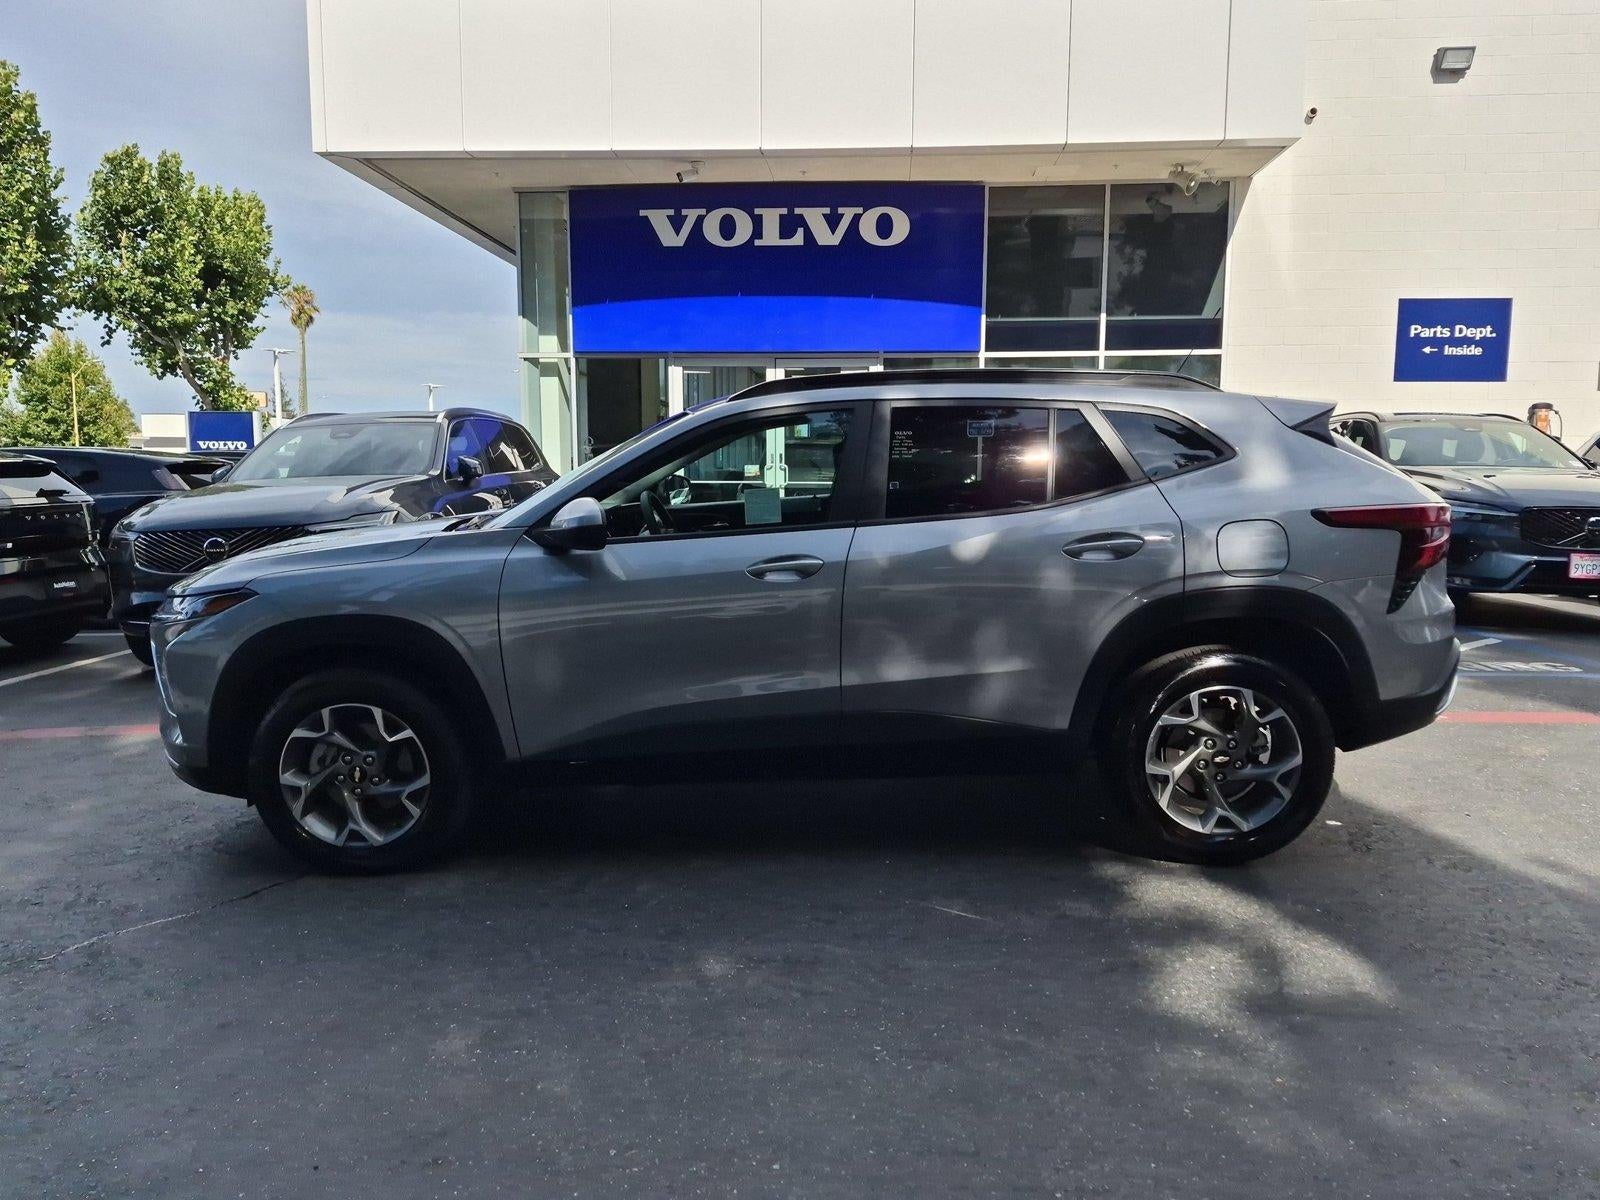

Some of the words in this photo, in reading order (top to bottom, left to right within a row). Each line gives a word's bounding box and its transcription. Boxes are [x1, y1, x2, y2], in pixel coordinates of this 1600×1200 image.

[639, 206, 911, 247] VOLVO
[1409, 324, 1451, 338] Parts
[1454, 324, 1497, 341] Dept.
[1443, 344, 1483, 355] Inside
[197, 440, 248, 450] VOLVO
[25, 512, 81, 521] VOLVO
[1574, 563, 1600, 575] 9YGP
